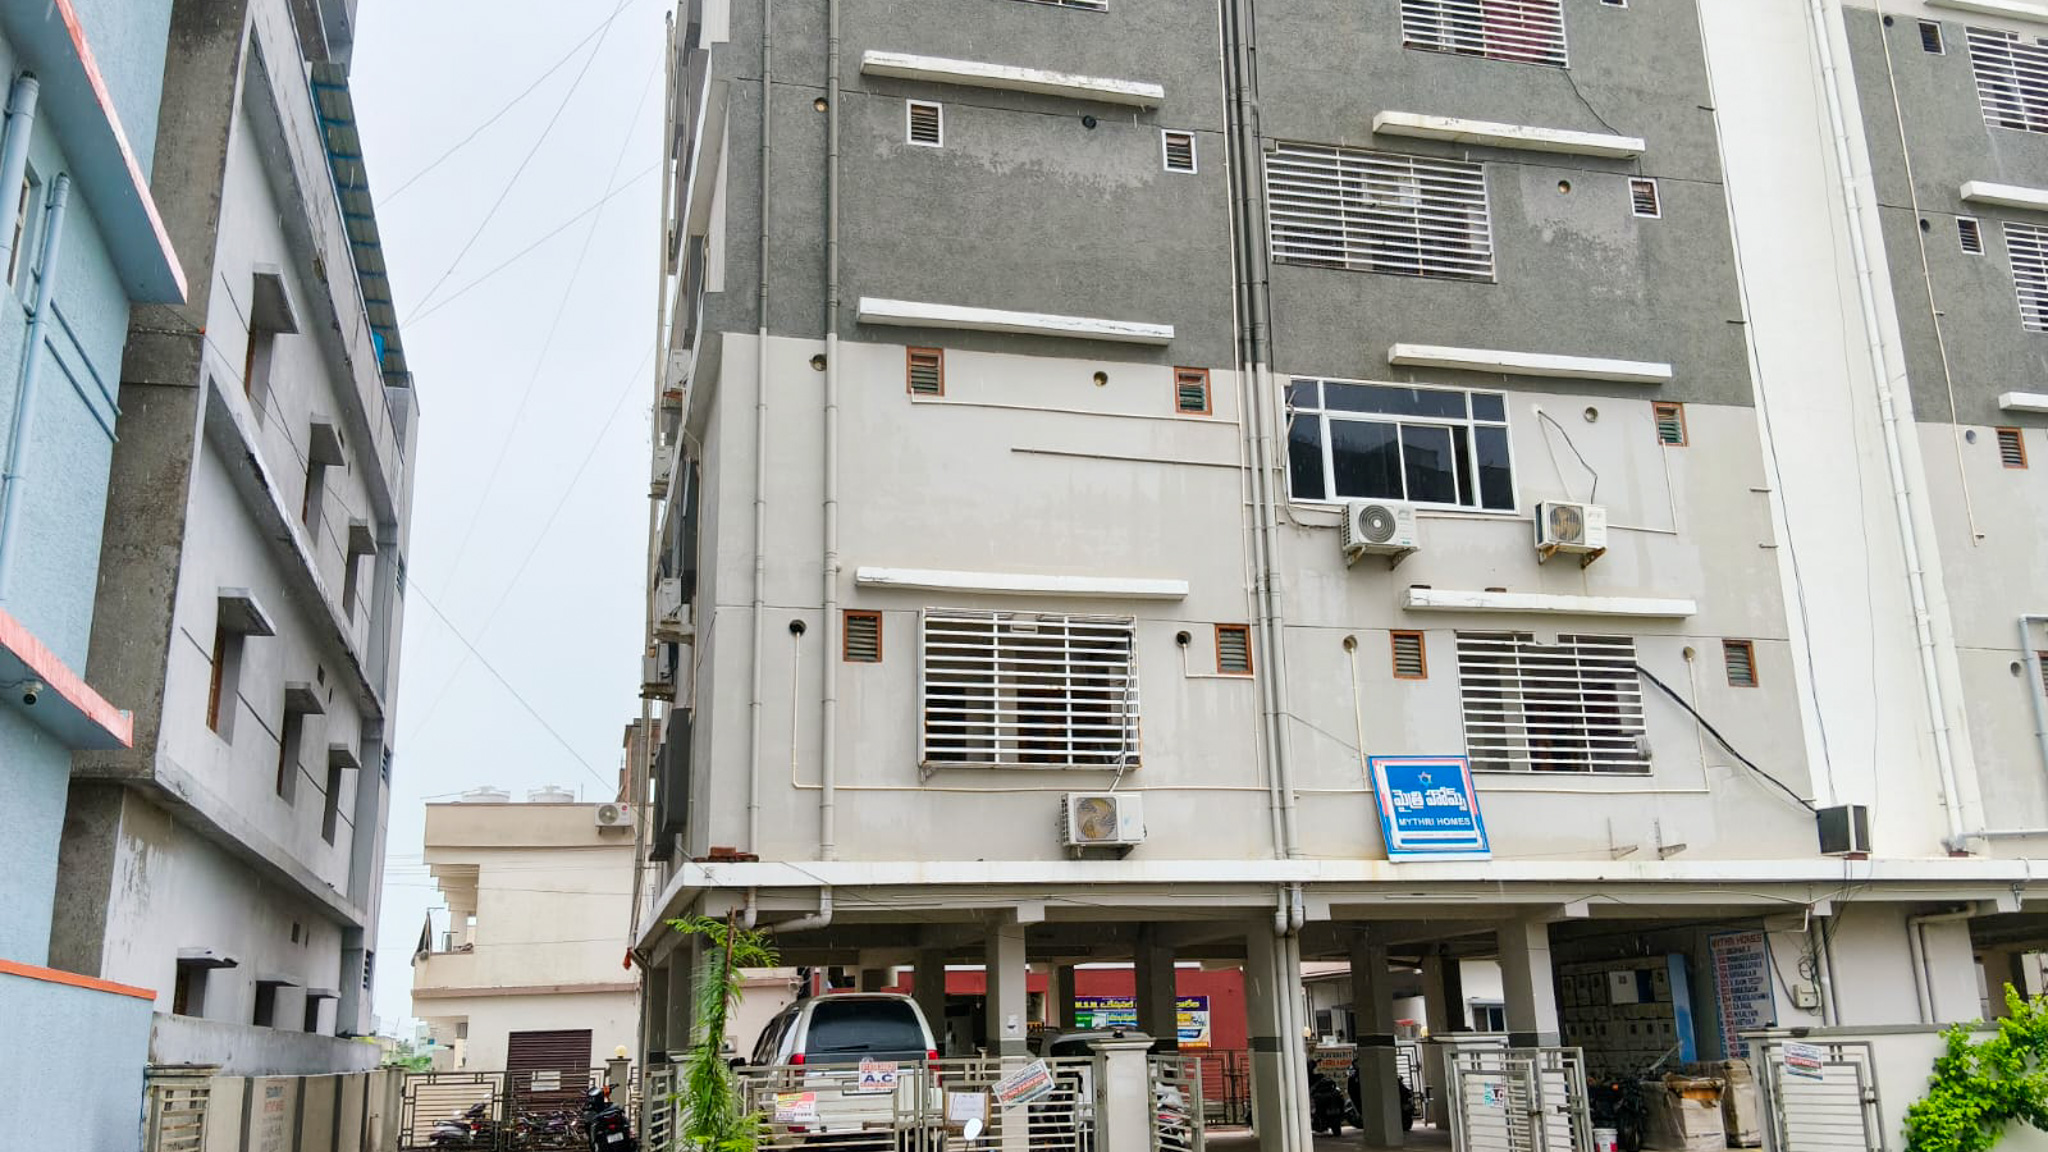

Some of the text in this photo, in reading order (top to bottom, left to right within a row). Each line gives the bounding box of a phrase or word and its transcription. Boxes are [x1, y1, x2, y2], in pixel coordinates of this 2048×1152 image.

[1399, 818, 1471, 826] MYTHRI HOMES
[864, 1074, 893, 1082] A.C
